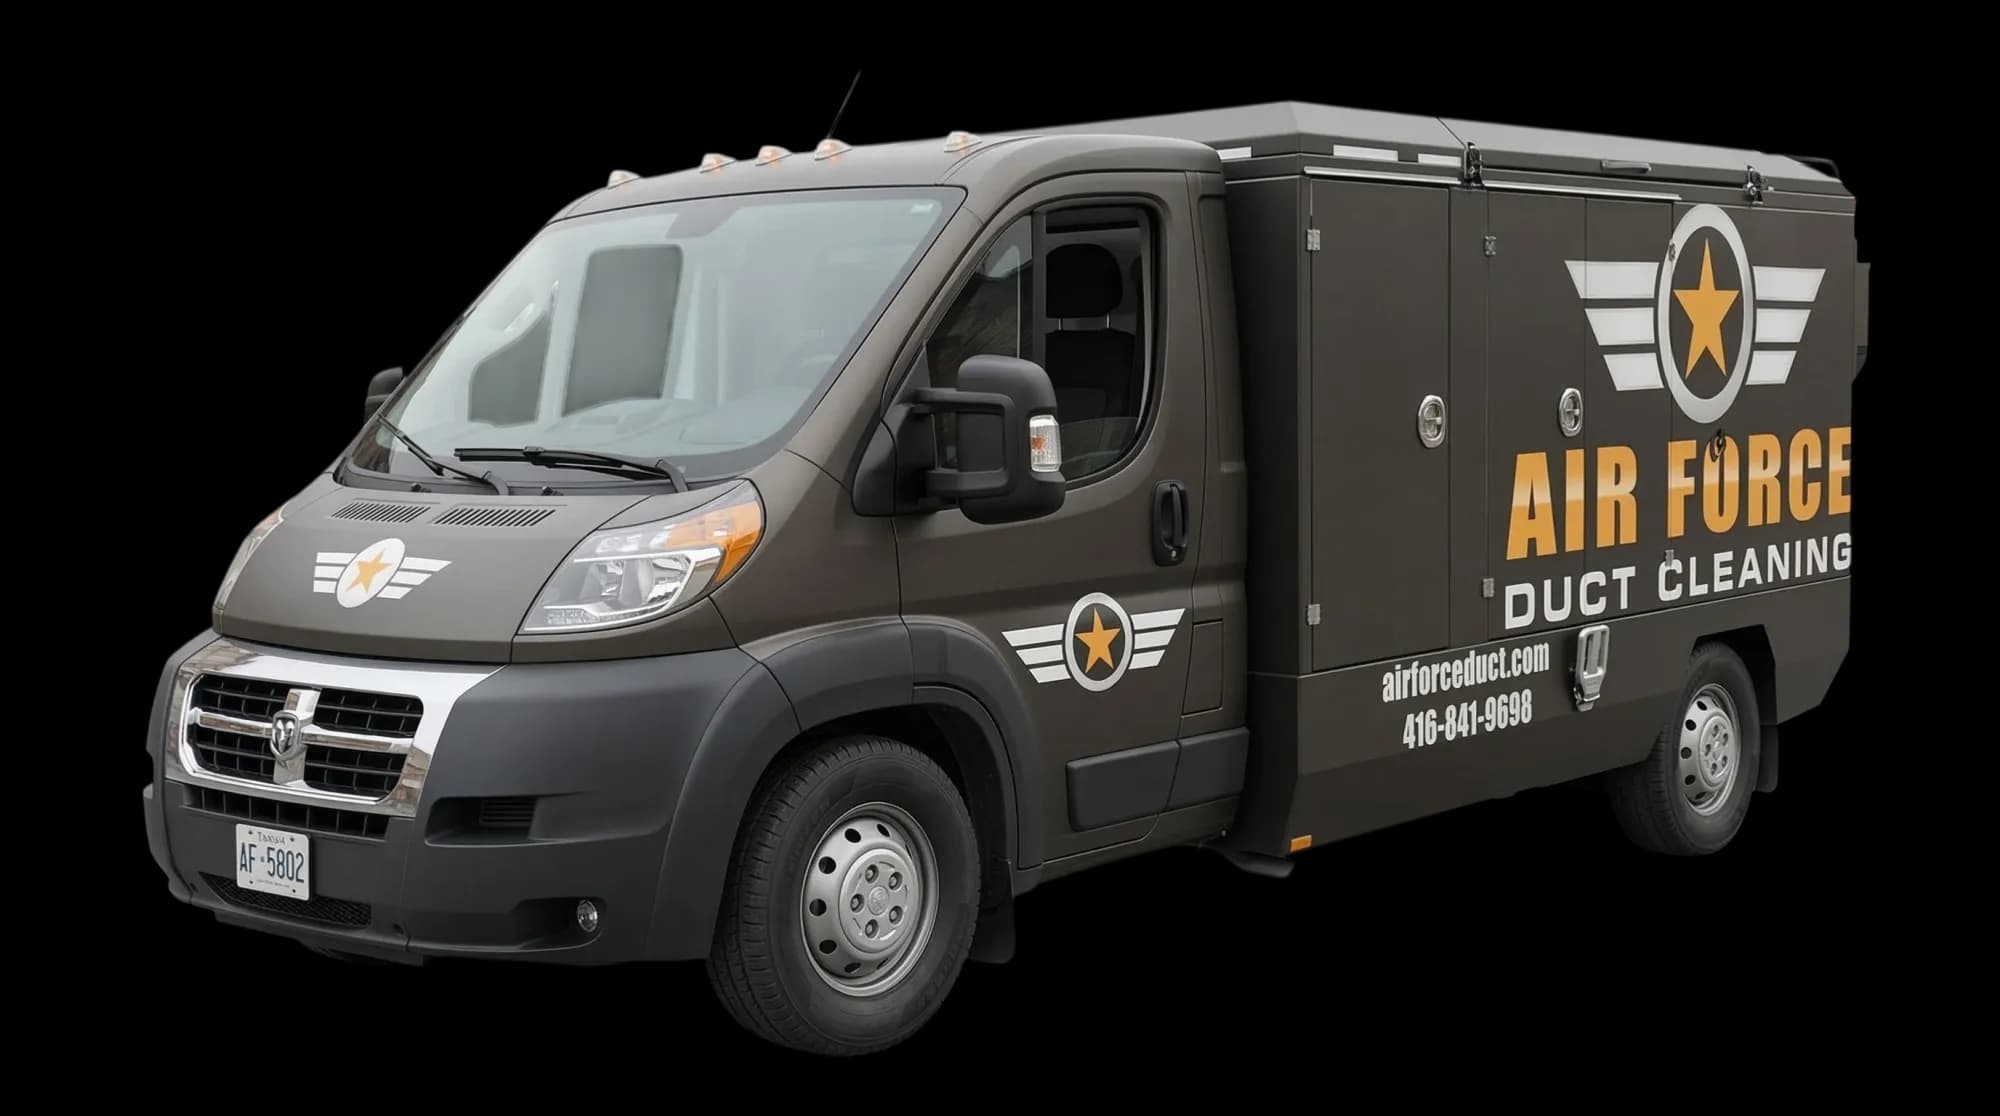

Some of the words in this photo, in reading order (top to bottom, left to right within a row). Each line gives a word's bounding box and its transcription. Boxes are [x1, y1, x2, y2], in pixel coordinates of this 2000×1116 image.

[1506, 446, 1638, 560] AIR
[1667, 426, 1851, 538] FORCE
[1505, 566, 1636, 629] DUCT
[1658, 532, 1851, 601] CLEANING
[1382, 642, 1549, 702] airforceduct.com
[1403, 689, 1532, 748] 416-841-9698
